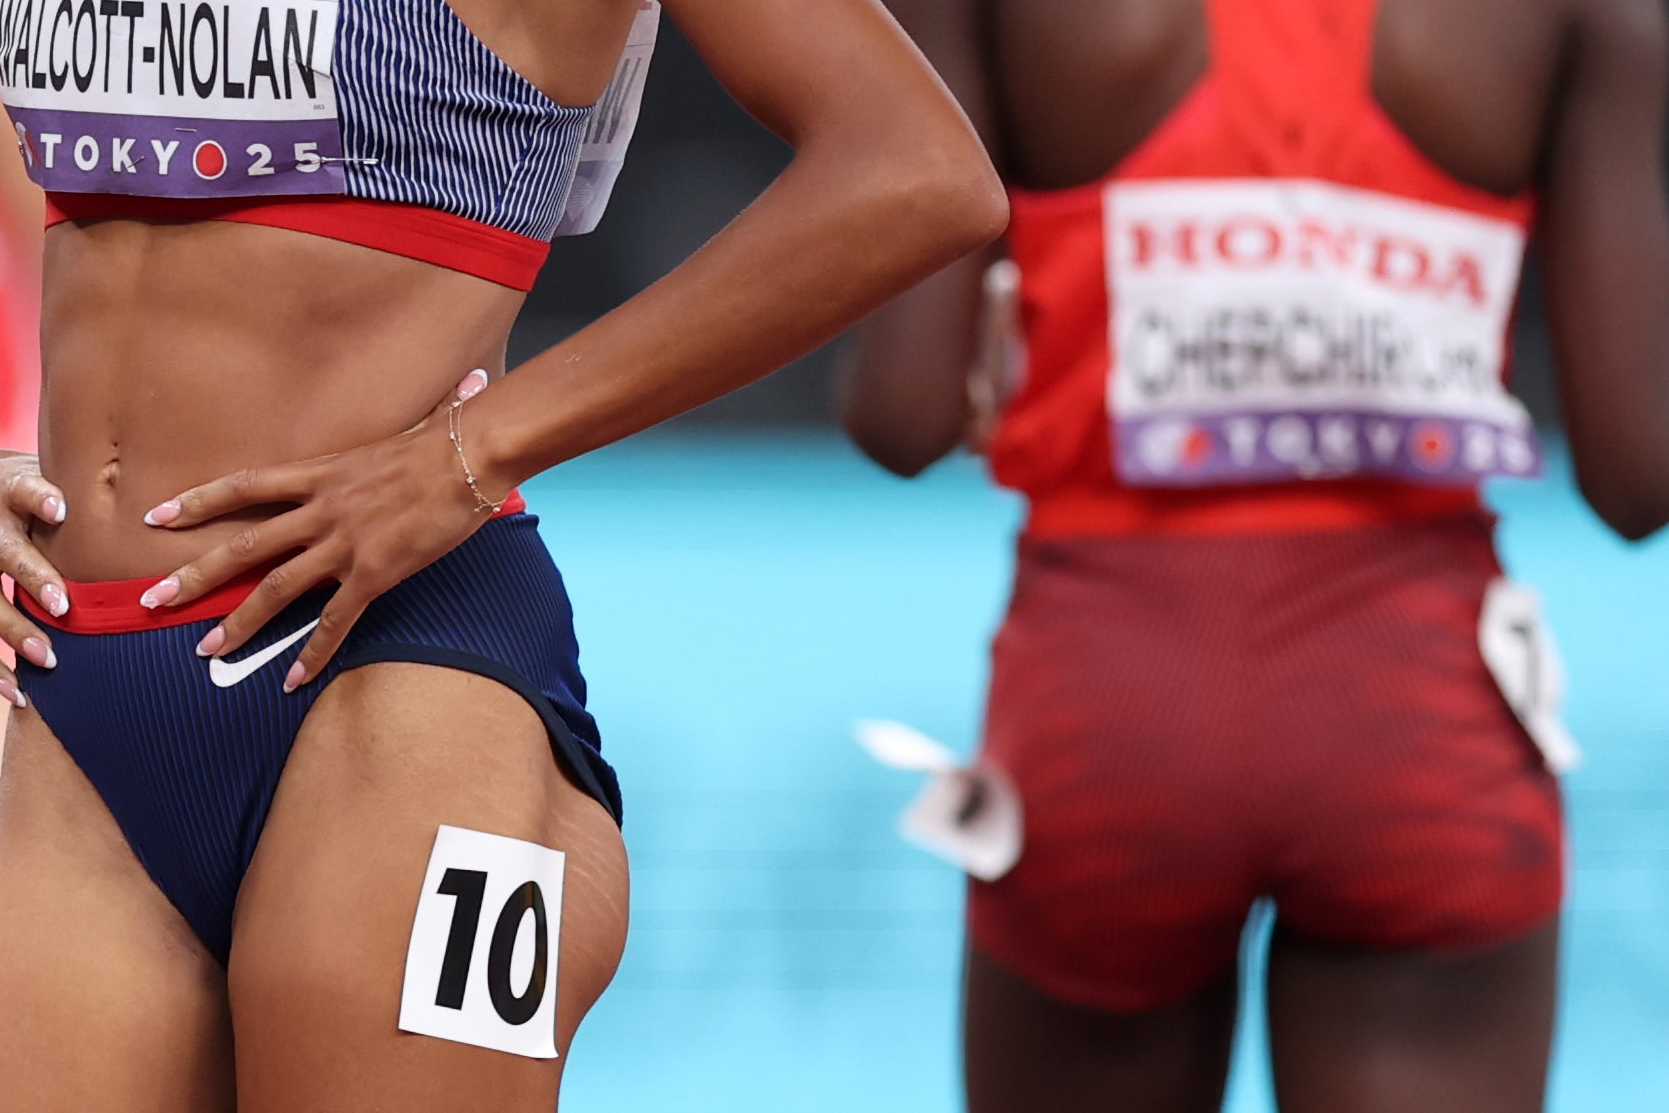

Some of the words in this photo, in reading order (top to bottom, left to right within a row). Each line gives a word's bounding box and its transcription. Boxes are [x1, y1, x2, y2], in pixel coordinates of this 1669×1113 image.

[244, 142, 323, 177] 25
[1129, 216, 1488, 309] HONDA
[433, 866, 549, 1026] 10
